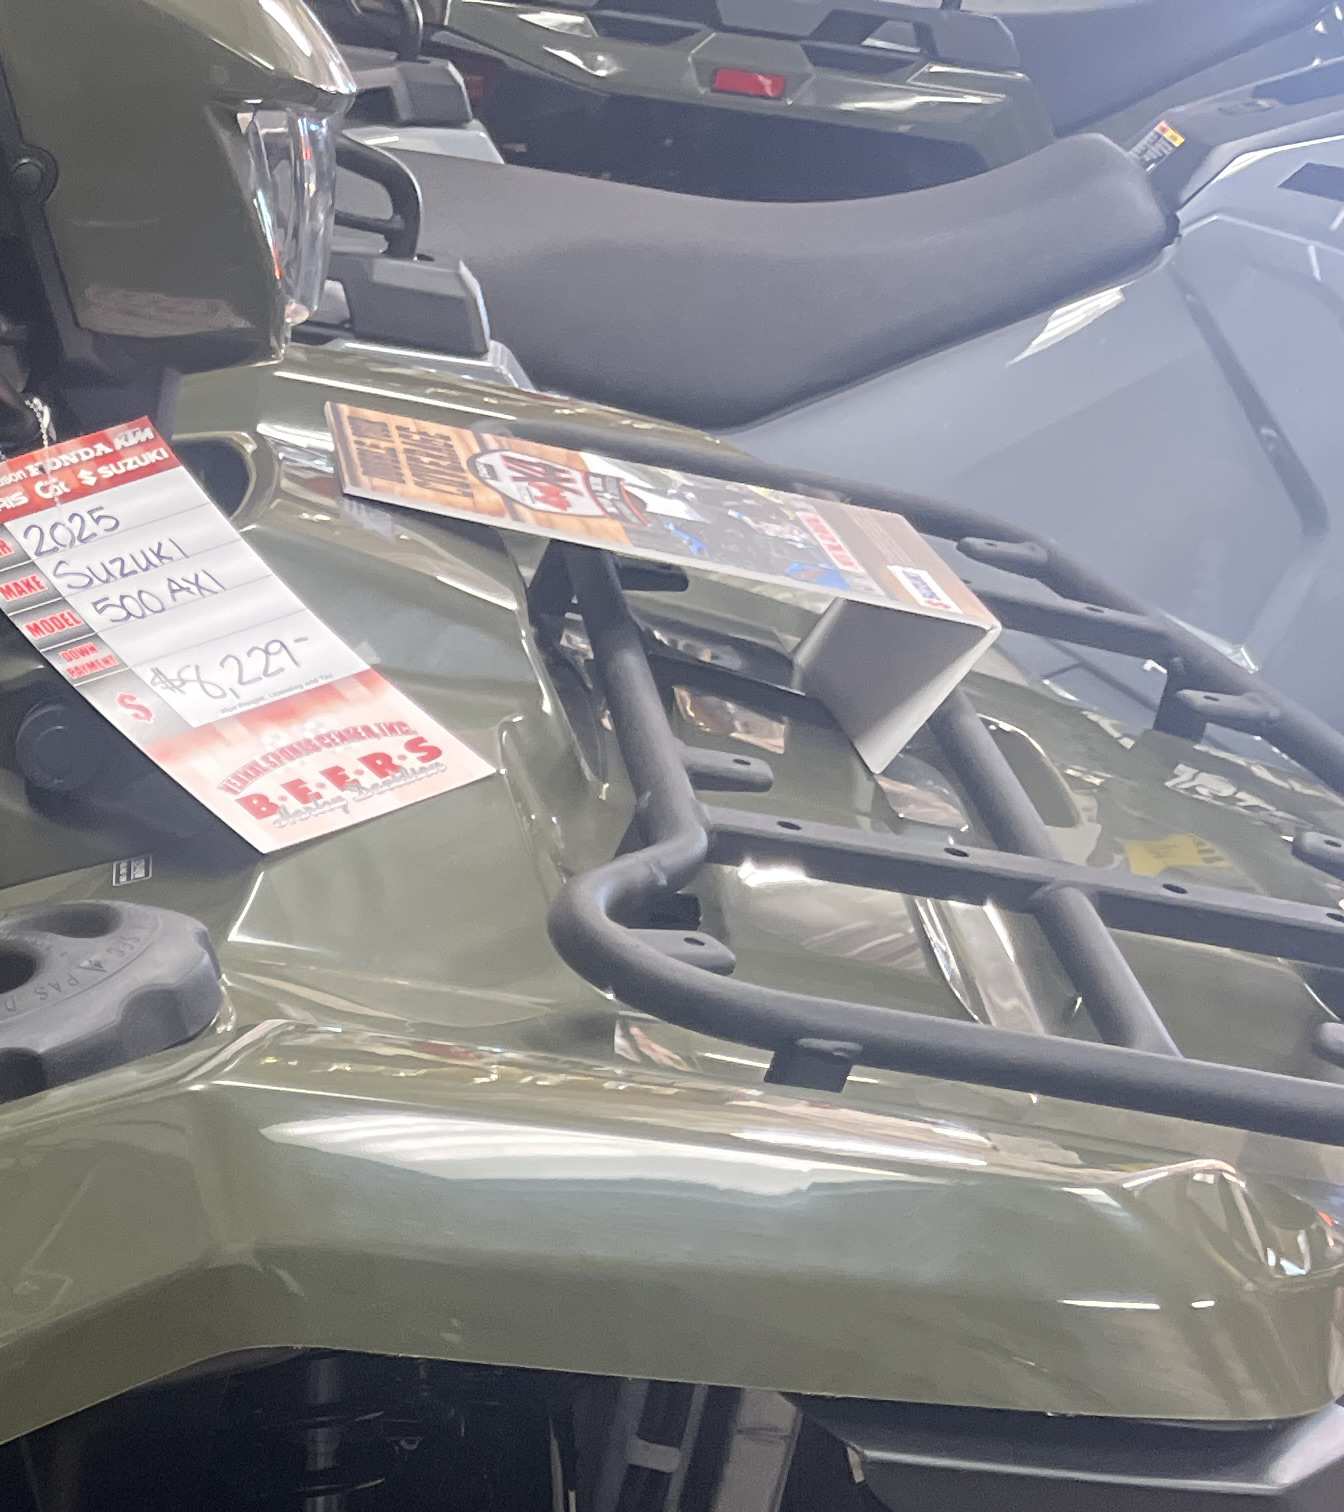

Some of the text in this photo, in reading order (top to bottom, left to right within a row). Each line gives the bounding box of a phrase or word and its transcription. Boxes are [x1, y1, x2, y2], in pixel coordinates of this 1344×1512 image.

[25, 442, 113, 476] HONDA
[113, 425, 155, 450] KTM
[98, 446, 169, 480] SUZUKI
[395, 424, 474, 499] COVERAGE
[24, 505, 121, 556] 2025
[92, 569, 227, 624] 500 AXI
[25, 609, 82, 640] MODEL
[60, 642, 98, 664] DOWN
[66, 652, 120, 679] PAYMENT
[115, 691, 156, 724] $
[258, 737, 324, 769] SPORTS
